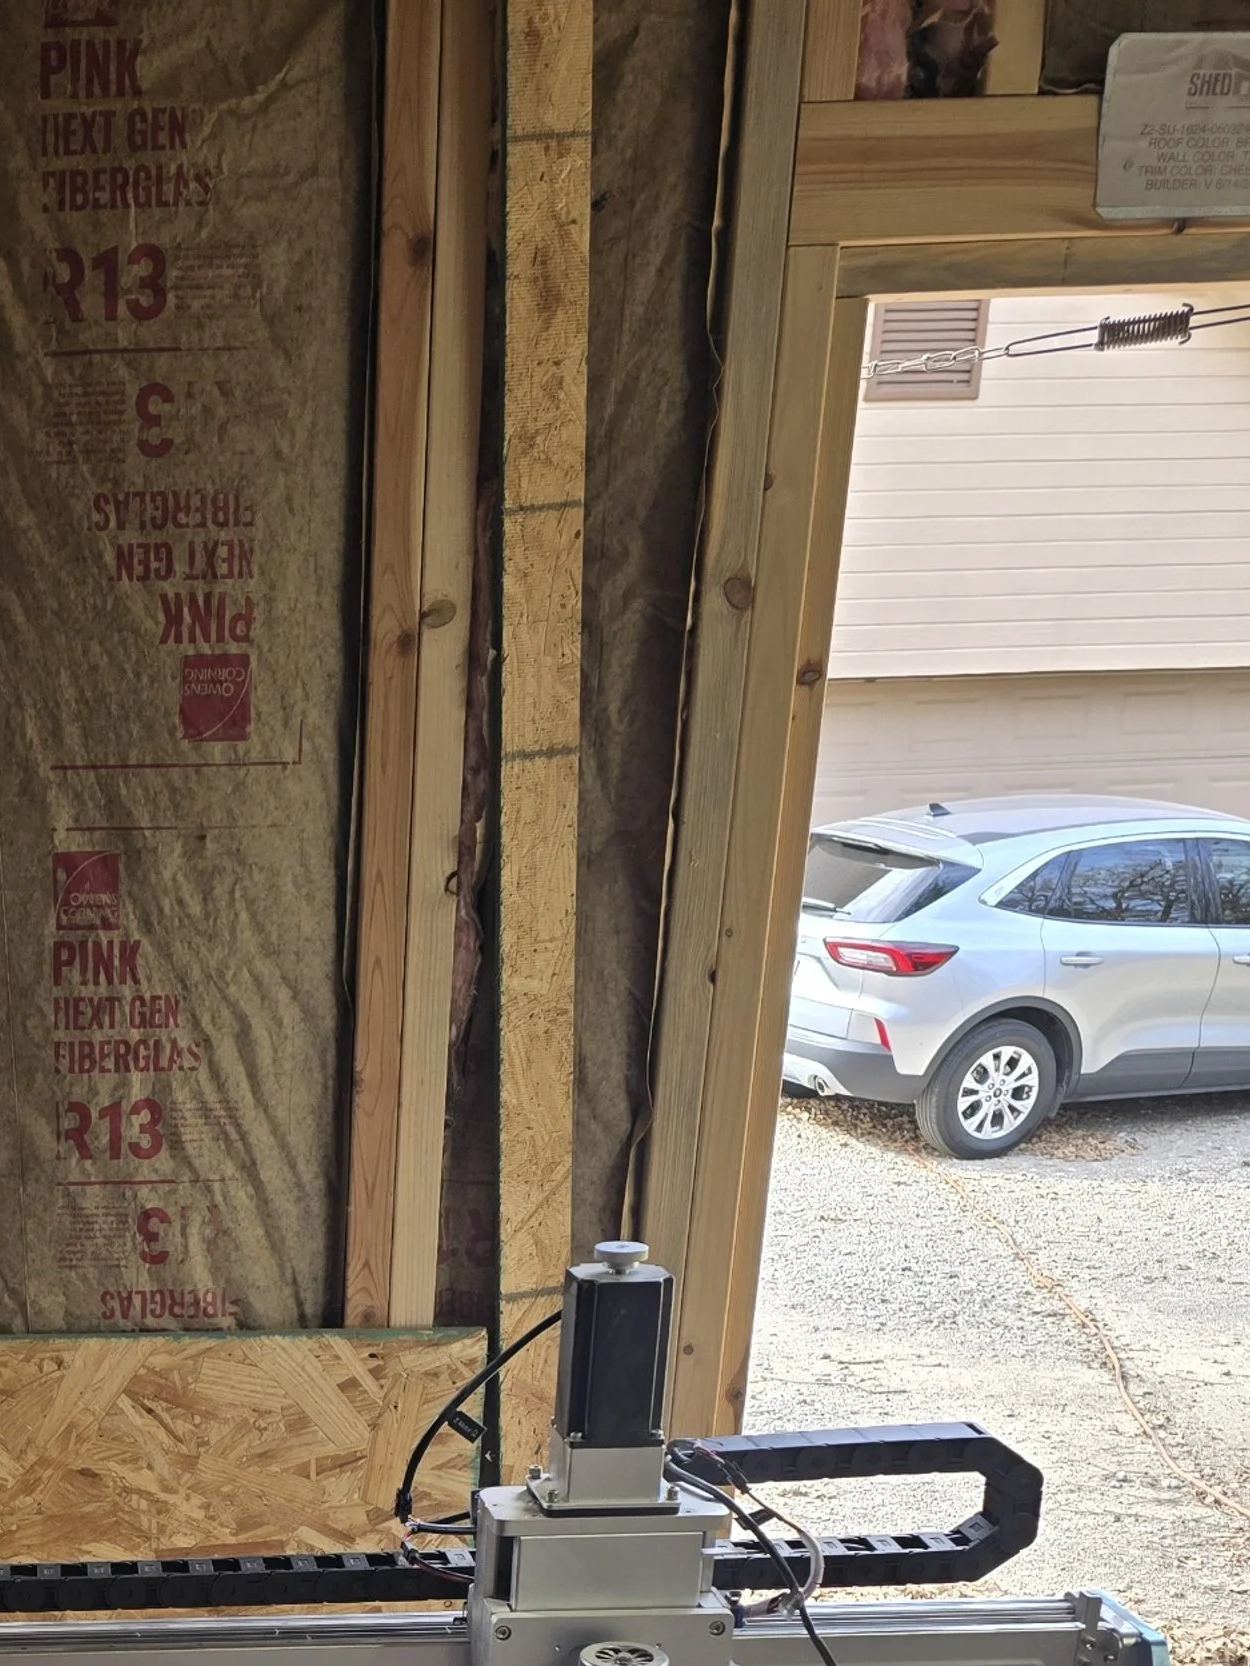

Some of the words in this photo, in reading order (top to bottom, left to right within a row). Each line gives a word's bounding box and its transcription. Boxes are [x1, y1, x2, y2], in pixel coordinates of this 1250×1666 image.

[39, 39, 142, 100] PINK
[1186, 72, 1232, 96] SHED
[40, 110, 115, 158] NEXT
[128, 107, 187, 152] GEN
[42, 165, 213, 213] FIBERGLAS
[44, 244, 168, 323] R13
[92, 490, 254, 530] FIBERGLAS
[116, 548, 174, 581] GEN
[185, 540, 254, 581] NEXT
[159, 594, 254, 644] PINK
[184, 667, 245, 681] CORNING
[184, 683, 234, 696] OWENS
[53, 940, 141, 986] PINK
[53, 996, 121, 1030] NEXT
[129, 995, 181, 1029] GEN
[54, 1039, 202, 1075] FIBERGLAS
[57, 1099, 163, 1160] R13
